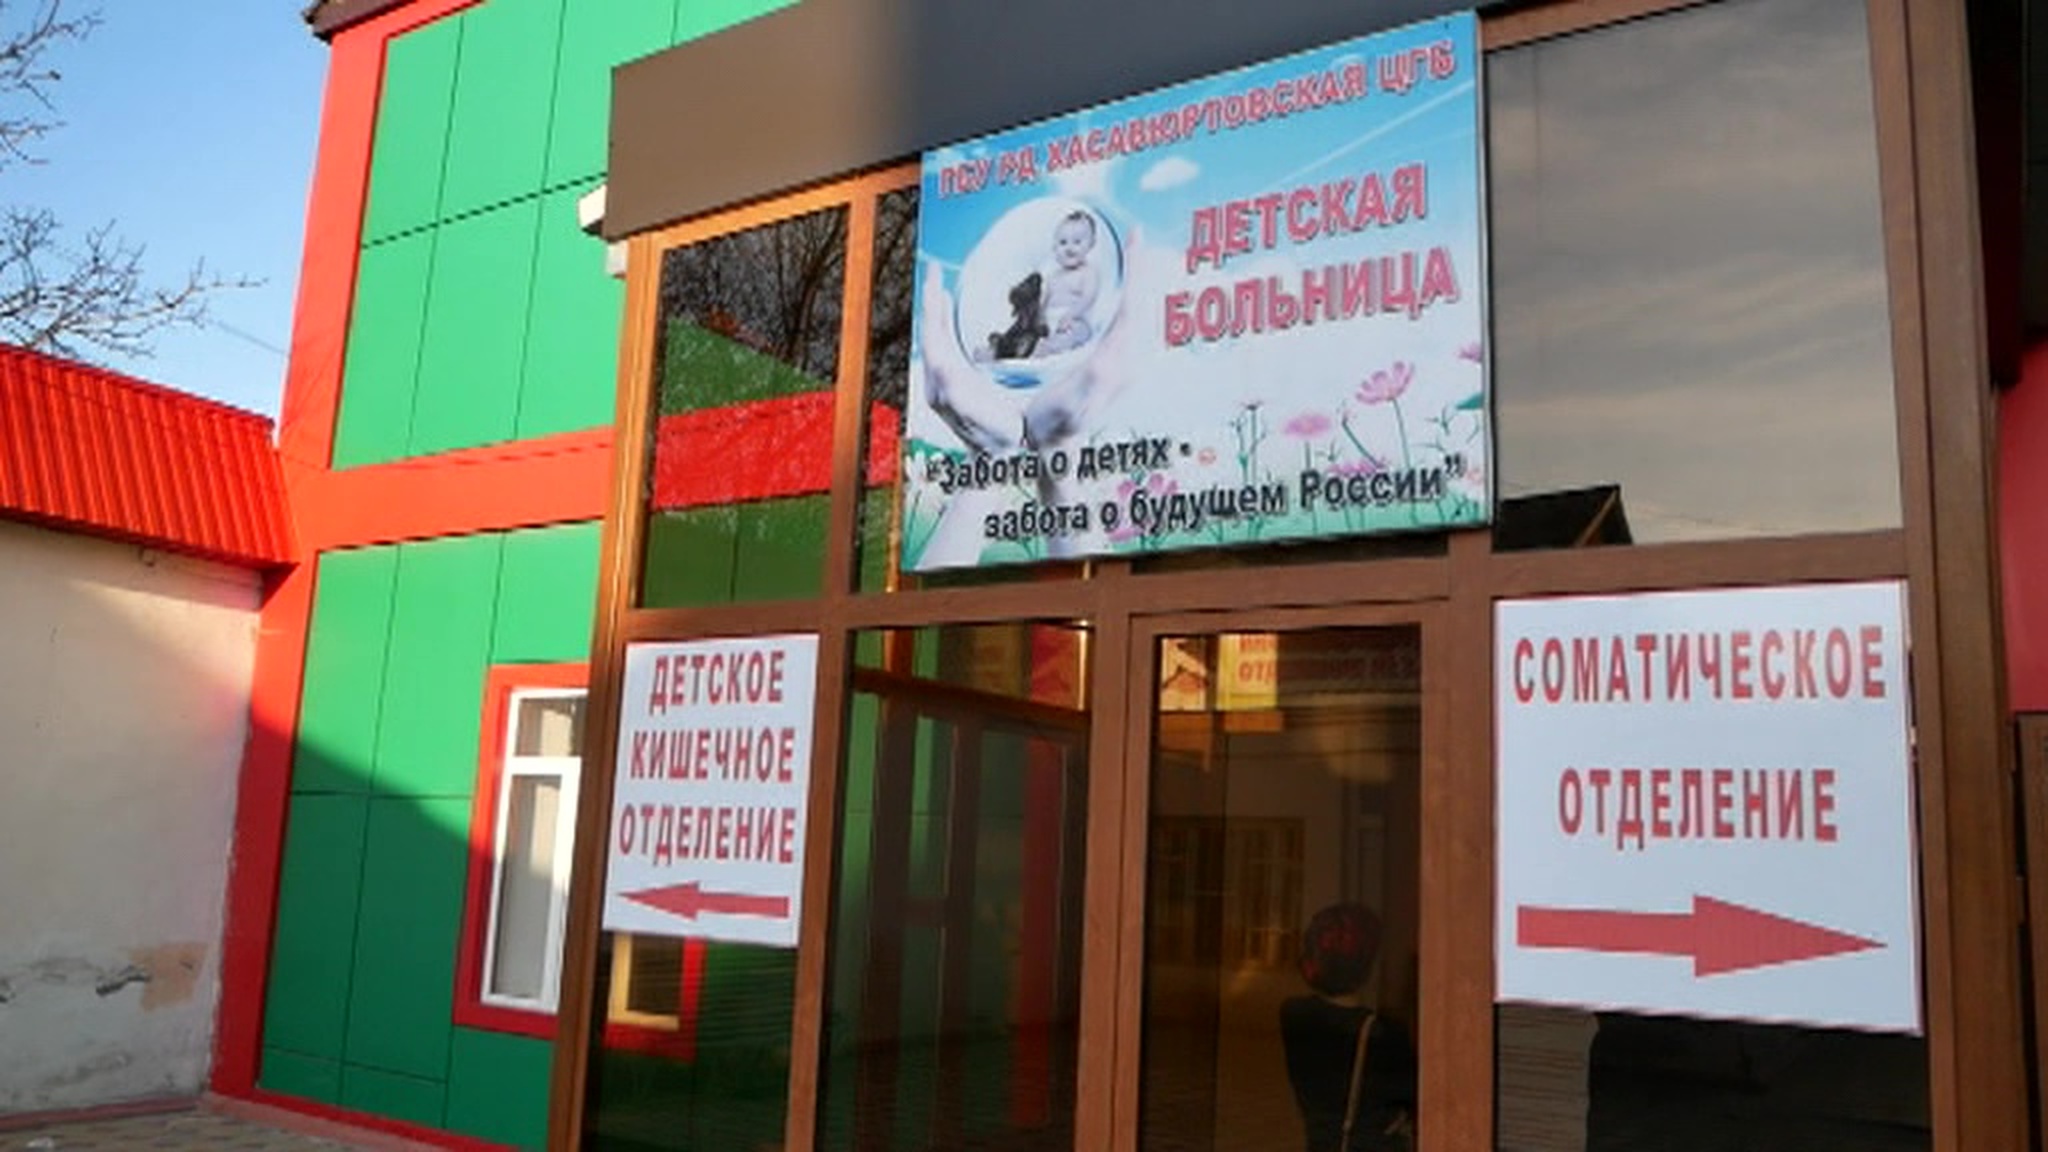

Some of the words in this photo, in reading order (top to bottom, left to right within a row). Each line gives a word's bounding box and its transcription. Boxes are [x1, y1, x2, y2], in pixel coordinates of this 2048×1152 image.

[997, 146, 1036, 186] РД
[1047, 63, 1368, 172] ХАСАВЮРТОВСКАЯ
[1378, 40, 1455, 96] ЦГБ
[1186, 163, 1428, 274] ДЕТСКАЯ
[1165, 247, 1460, 347] БОЛЬНИЦА
[1050, 450, 1069, 475] о
[1077, 438, 1171, 480] детях
[984, 503, 1088, 540] забота
[1101, 501, 1119, 531] о
[1130, 490, 1288, 534] будущем
[650, 651, 785, 715] ДЕТСКОЕ
[1513, 626, 1886, 702] СОМАТИЧЕСКОЕ
[630, 728, 795, 782] КИШЕЧНОЕ
[619, 803, 797, 866] ОТДЕЛЕНИЕ
[1558, 768, 1838, 850] ОТДЕЛЕНИЕ
